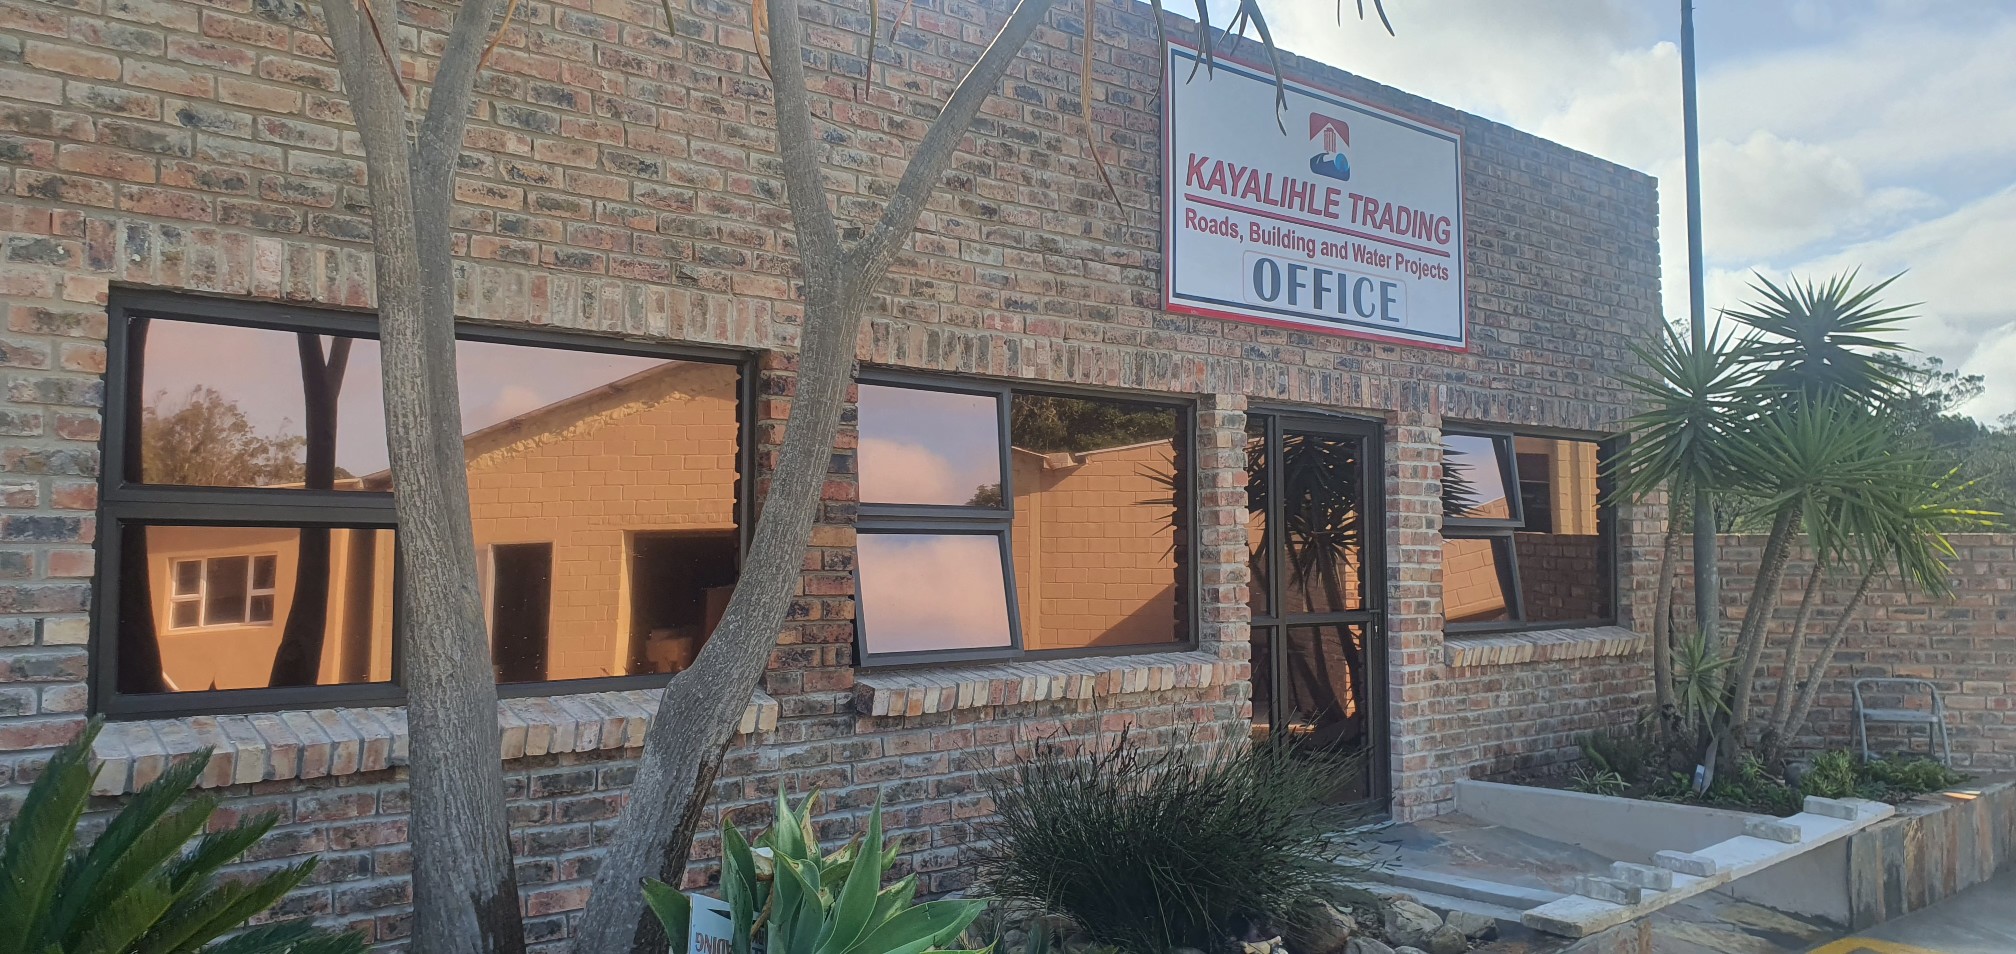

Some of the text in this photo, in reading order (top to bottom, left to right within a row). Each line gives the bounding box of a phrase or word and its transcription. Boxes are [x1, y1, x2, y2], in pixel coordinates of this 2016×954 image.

[1186, 153, 1451, 245] KAYALIHLE TRADING
[1185, 207, 1449, 280] Roads, Building and Water Projects
[1252, 257, 1400, 323] OFFICE
